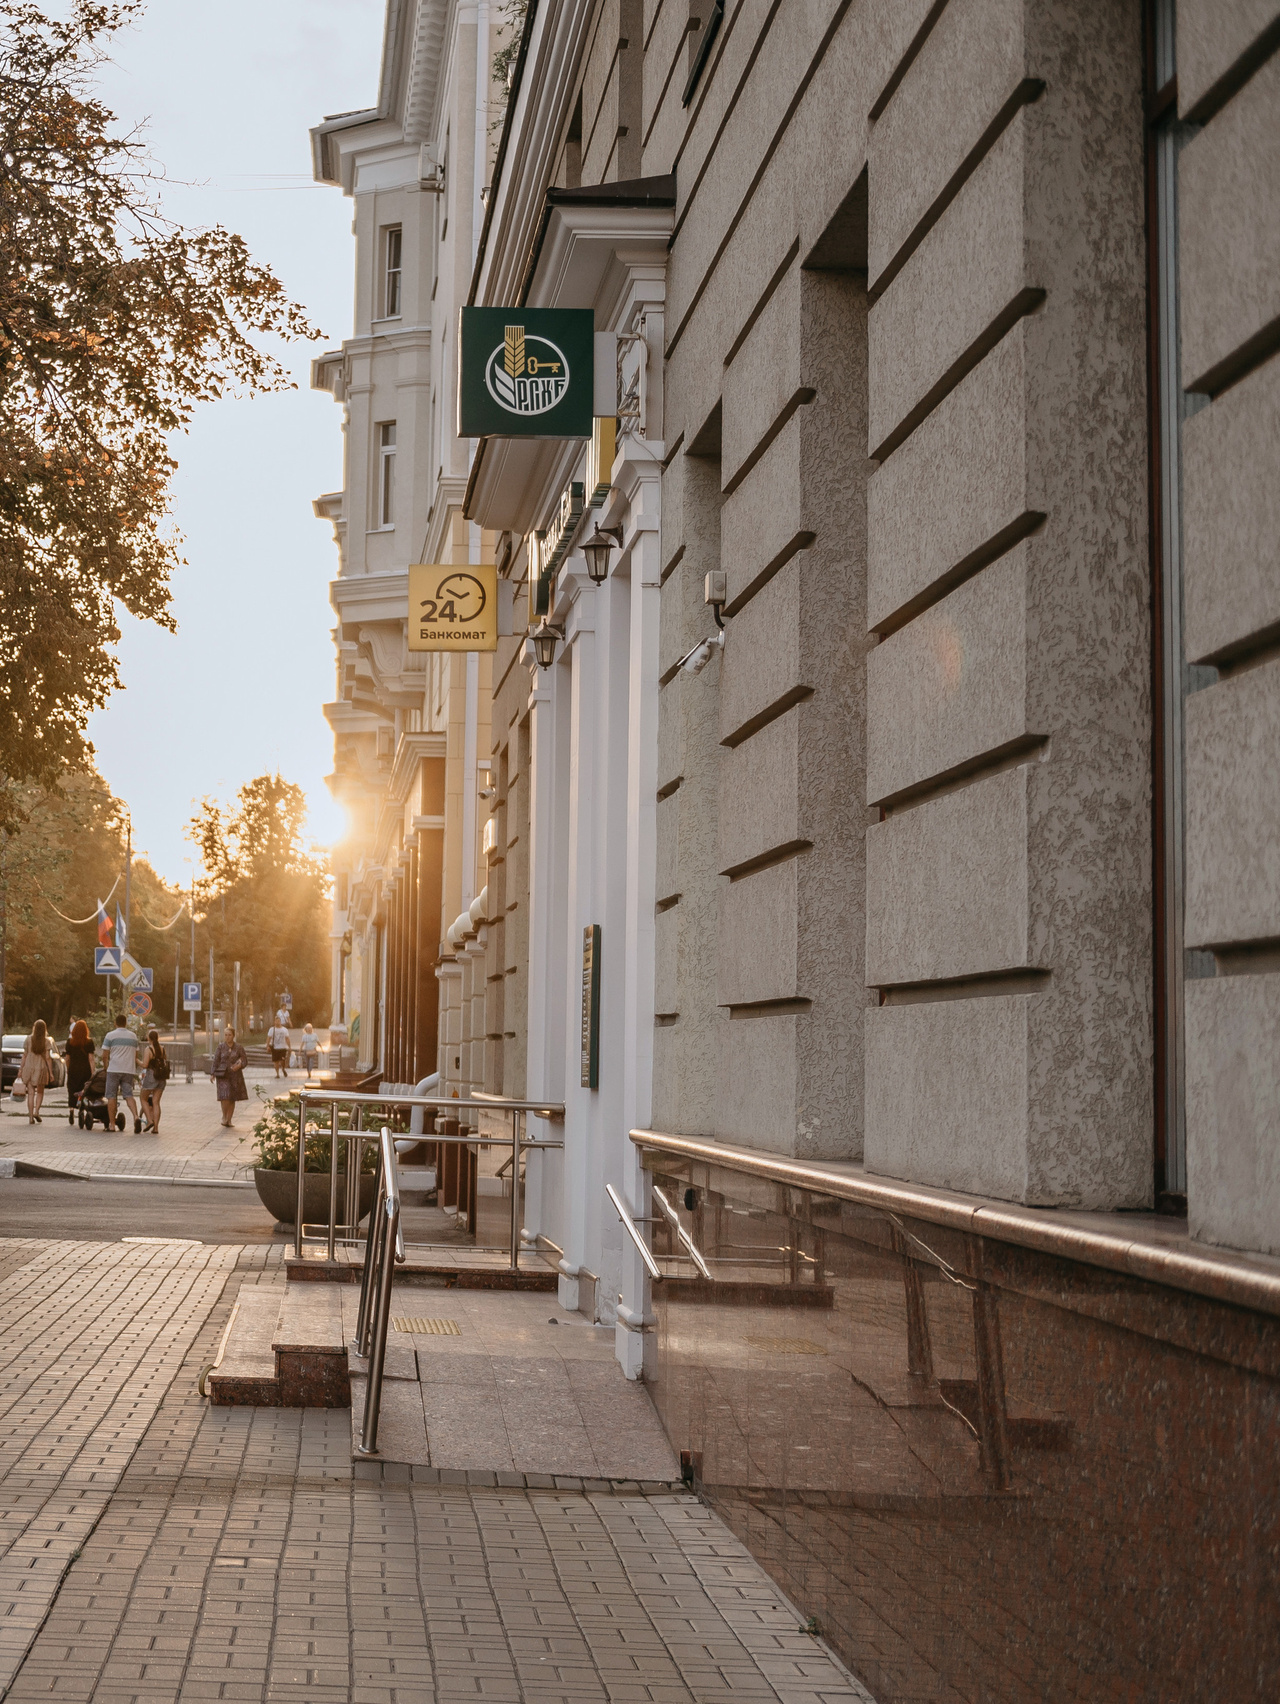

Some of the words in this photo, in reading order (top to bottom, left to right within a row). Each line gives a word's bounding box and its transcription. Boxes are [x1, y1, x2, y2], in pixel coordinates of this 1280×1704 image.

[516, 378, 566, 412] РСХБ
[420, 600, 457, 622] 24
[420, 629, 486, 639] Банкомат
[188, 985, 198, 999] P
